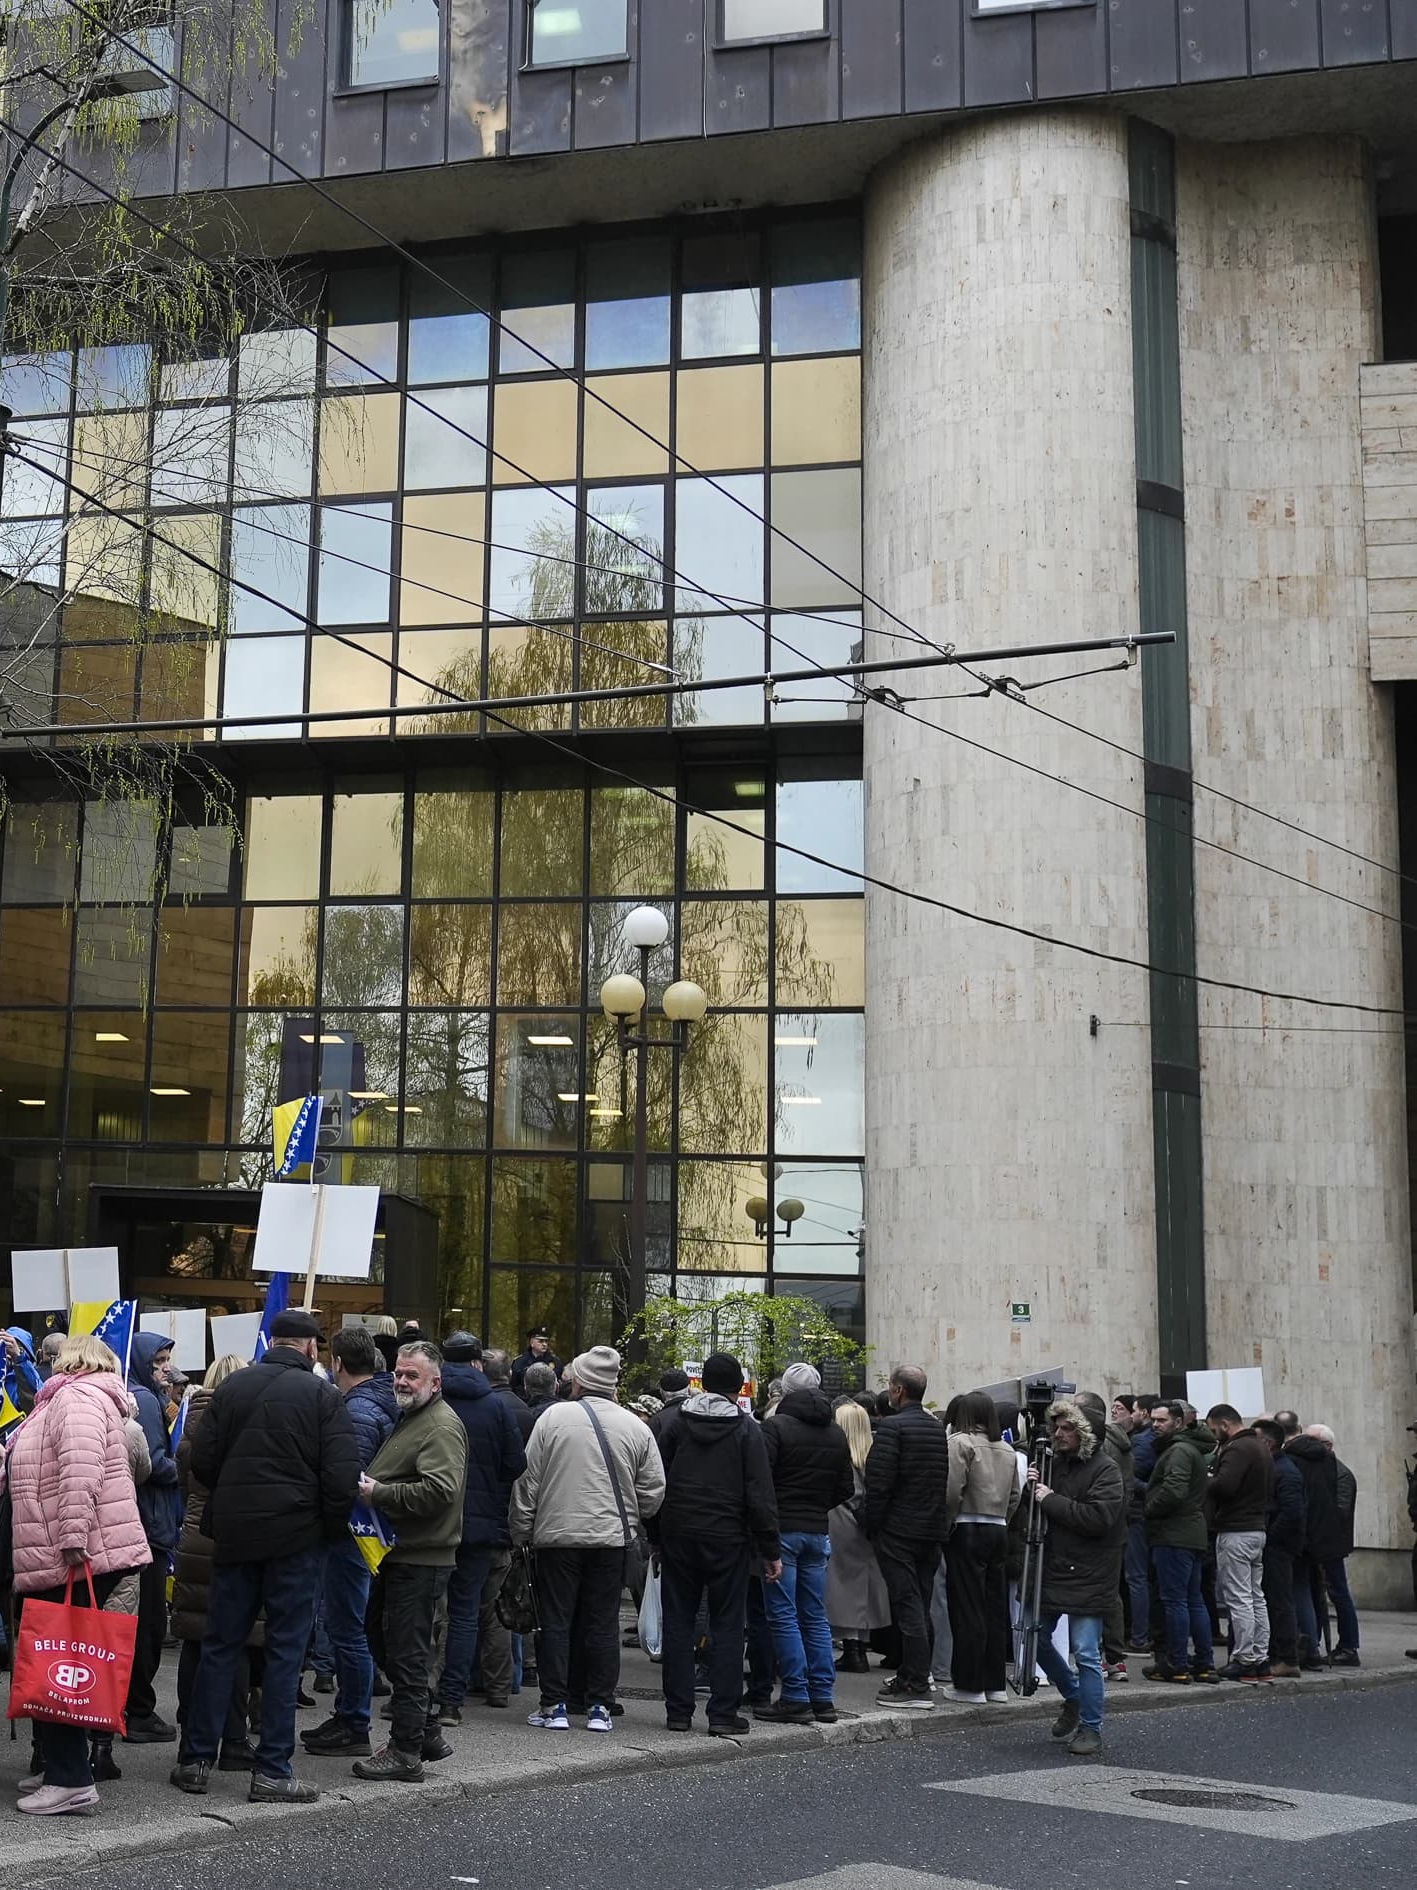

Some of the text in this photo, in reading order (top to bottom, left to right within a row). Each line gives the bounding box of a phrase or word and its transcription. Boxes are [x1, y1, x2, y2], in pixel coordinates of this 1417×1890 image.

[1017, 1305, 1025, 1314] 3
[34, 1639, 116, 1662] BELE GROUP
[48, 1690, 90, 1705] BELAPROM
